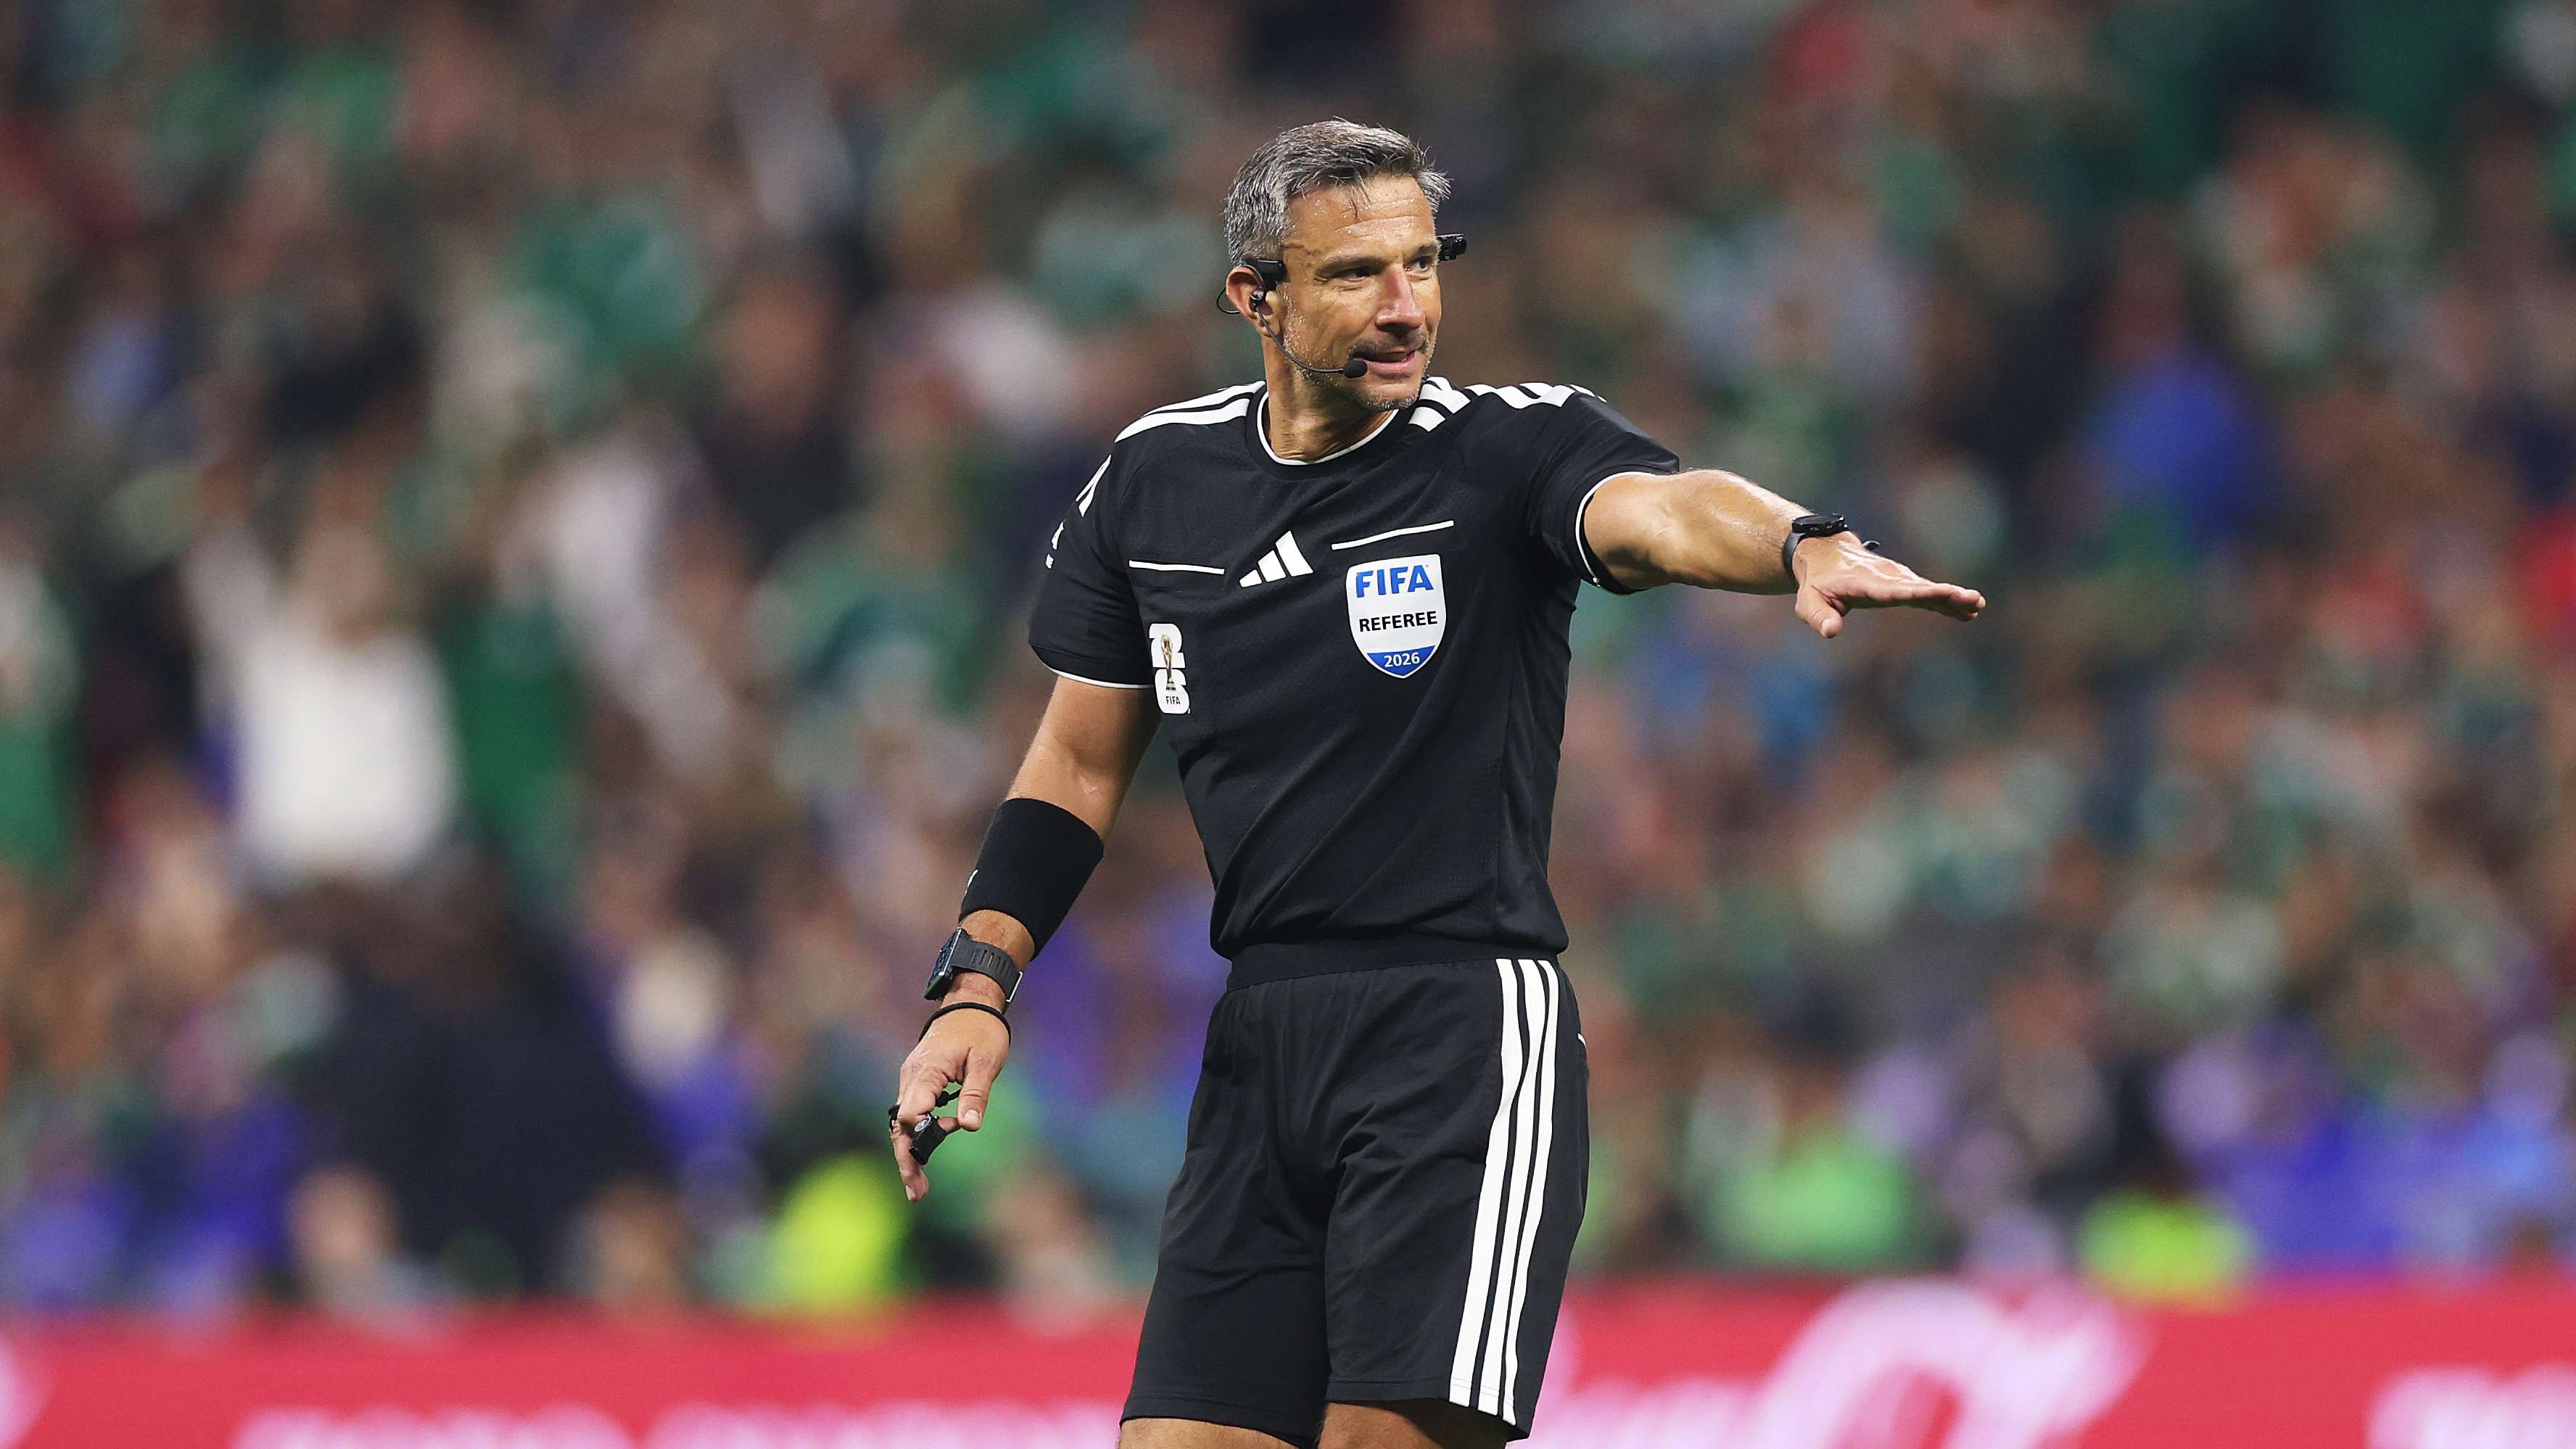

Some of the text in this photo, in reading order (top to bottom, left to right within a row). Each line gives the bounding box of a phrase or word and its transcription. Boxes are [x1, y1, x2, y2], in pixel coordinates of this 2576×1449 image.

[1355, 564, 1434, 598] FIFA
[1359, 611, 1437, 632] REFEREE
[1384, 652, 1420, 668] 2026
[1165, 695, 1181, 705] FIFA
